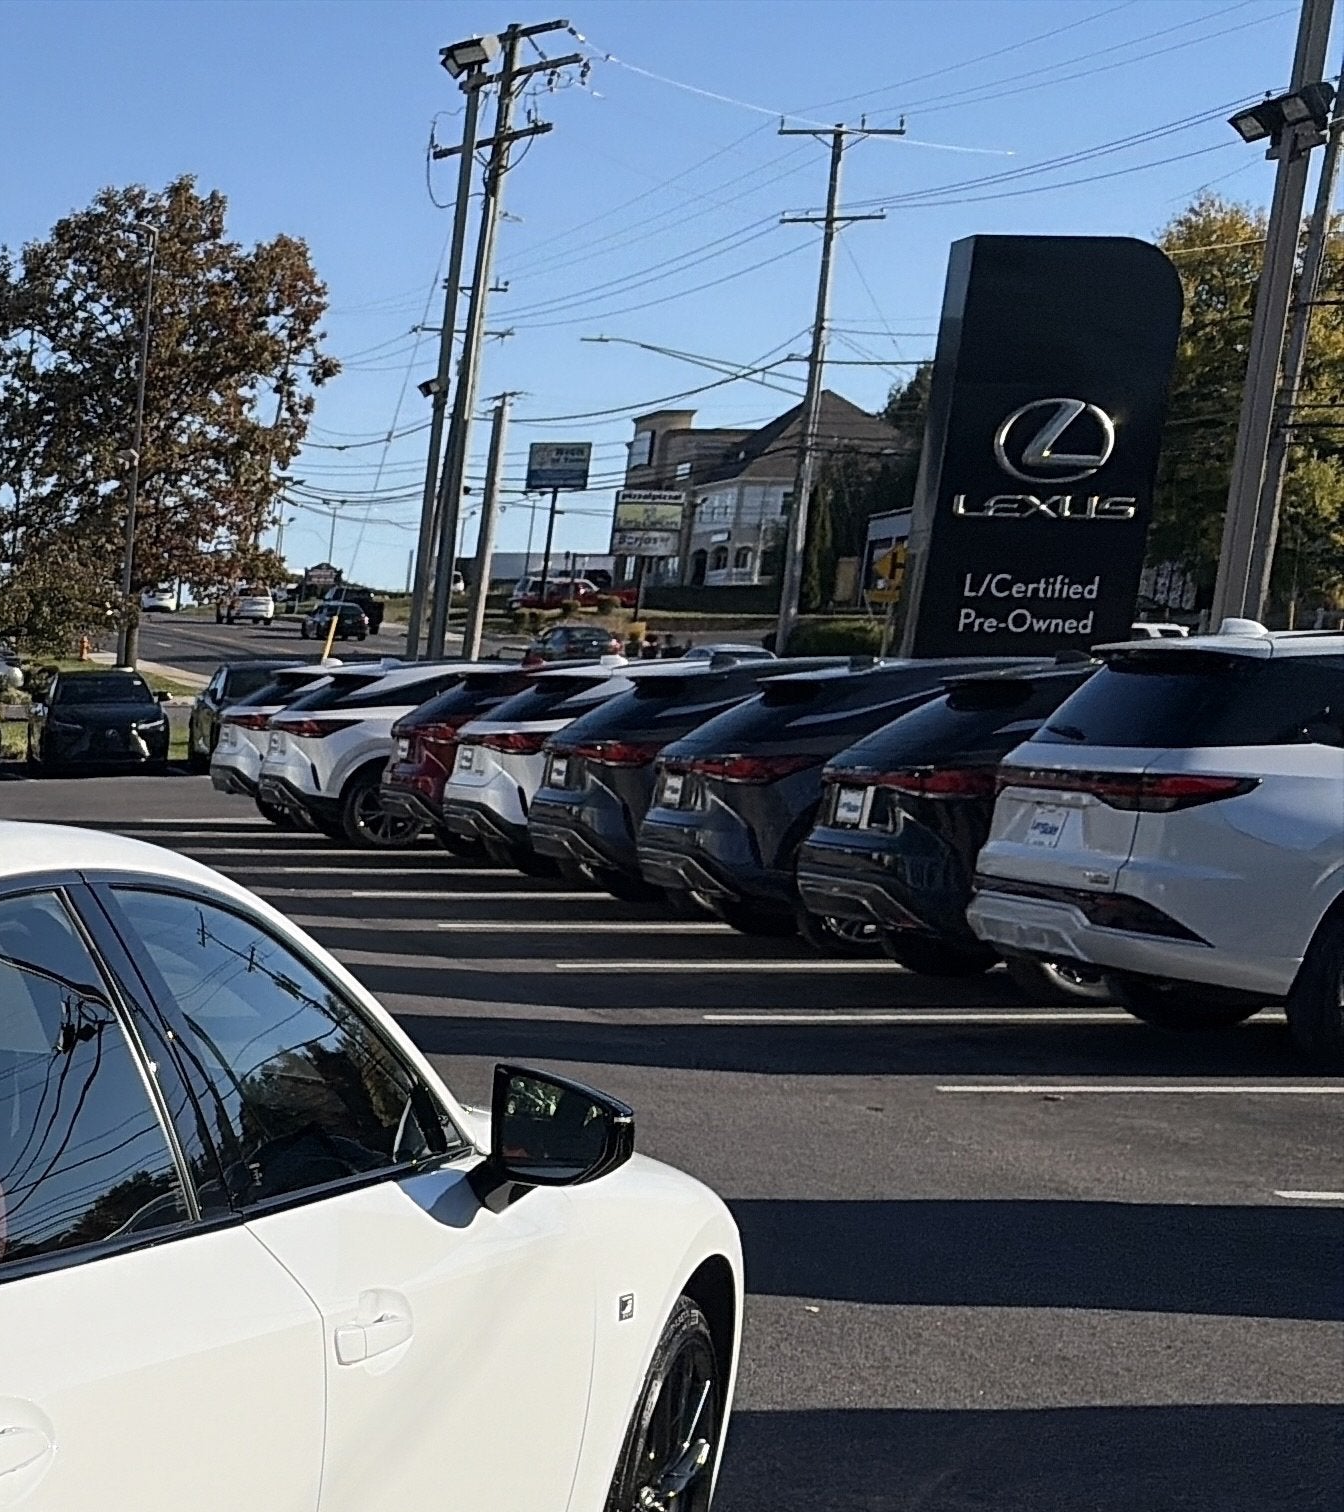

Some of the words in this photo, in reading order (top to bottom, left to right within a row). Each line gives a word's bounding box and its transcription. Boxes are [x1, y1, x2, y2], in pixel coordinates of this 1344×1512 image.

[953, 494, 1136, 519] LEXUS
[963, 573, 1100, 599] L/Certified
[957, 608, 1095, 634] Pre-Owned
